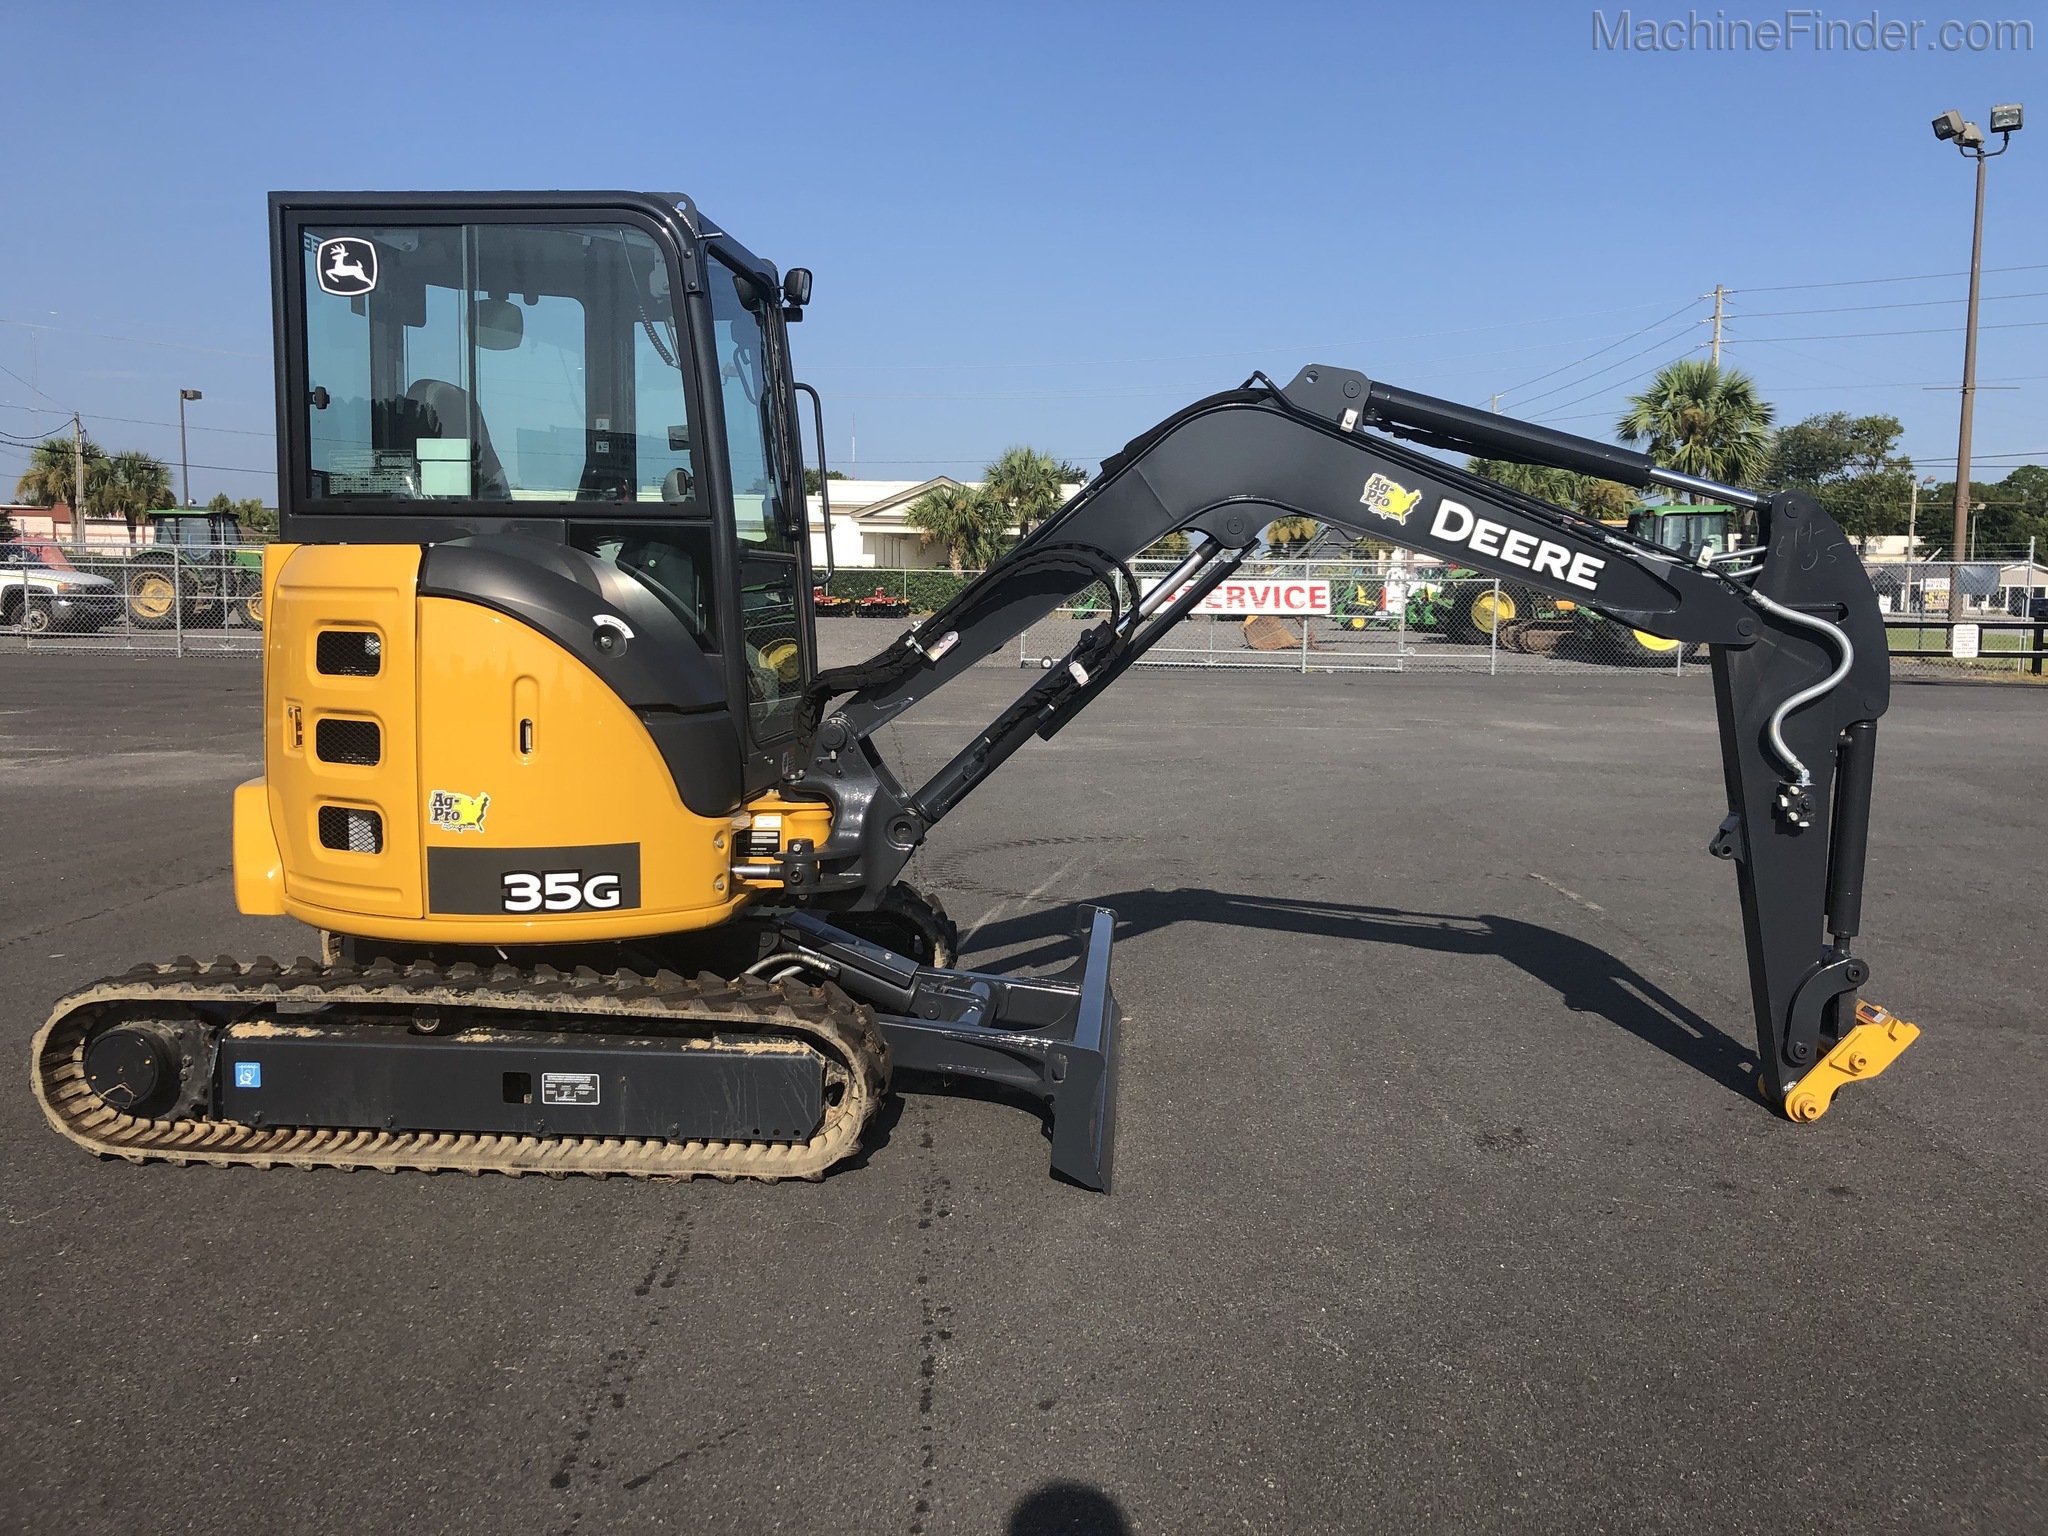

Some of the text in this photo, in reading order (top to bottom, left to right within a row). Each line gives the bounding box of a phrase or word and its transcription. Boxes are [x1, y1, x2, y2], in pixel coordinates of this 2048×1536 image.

[1368, 477, 1395, 495] Ag-
[1364, 489, 1391, 506] Pro
[1429, 498, 1606, 591] DEERE
[432, 793, 460, 810] Ag-
[432, 807, 461, 821] Pro
[502, 870, 620, 912] 35G
